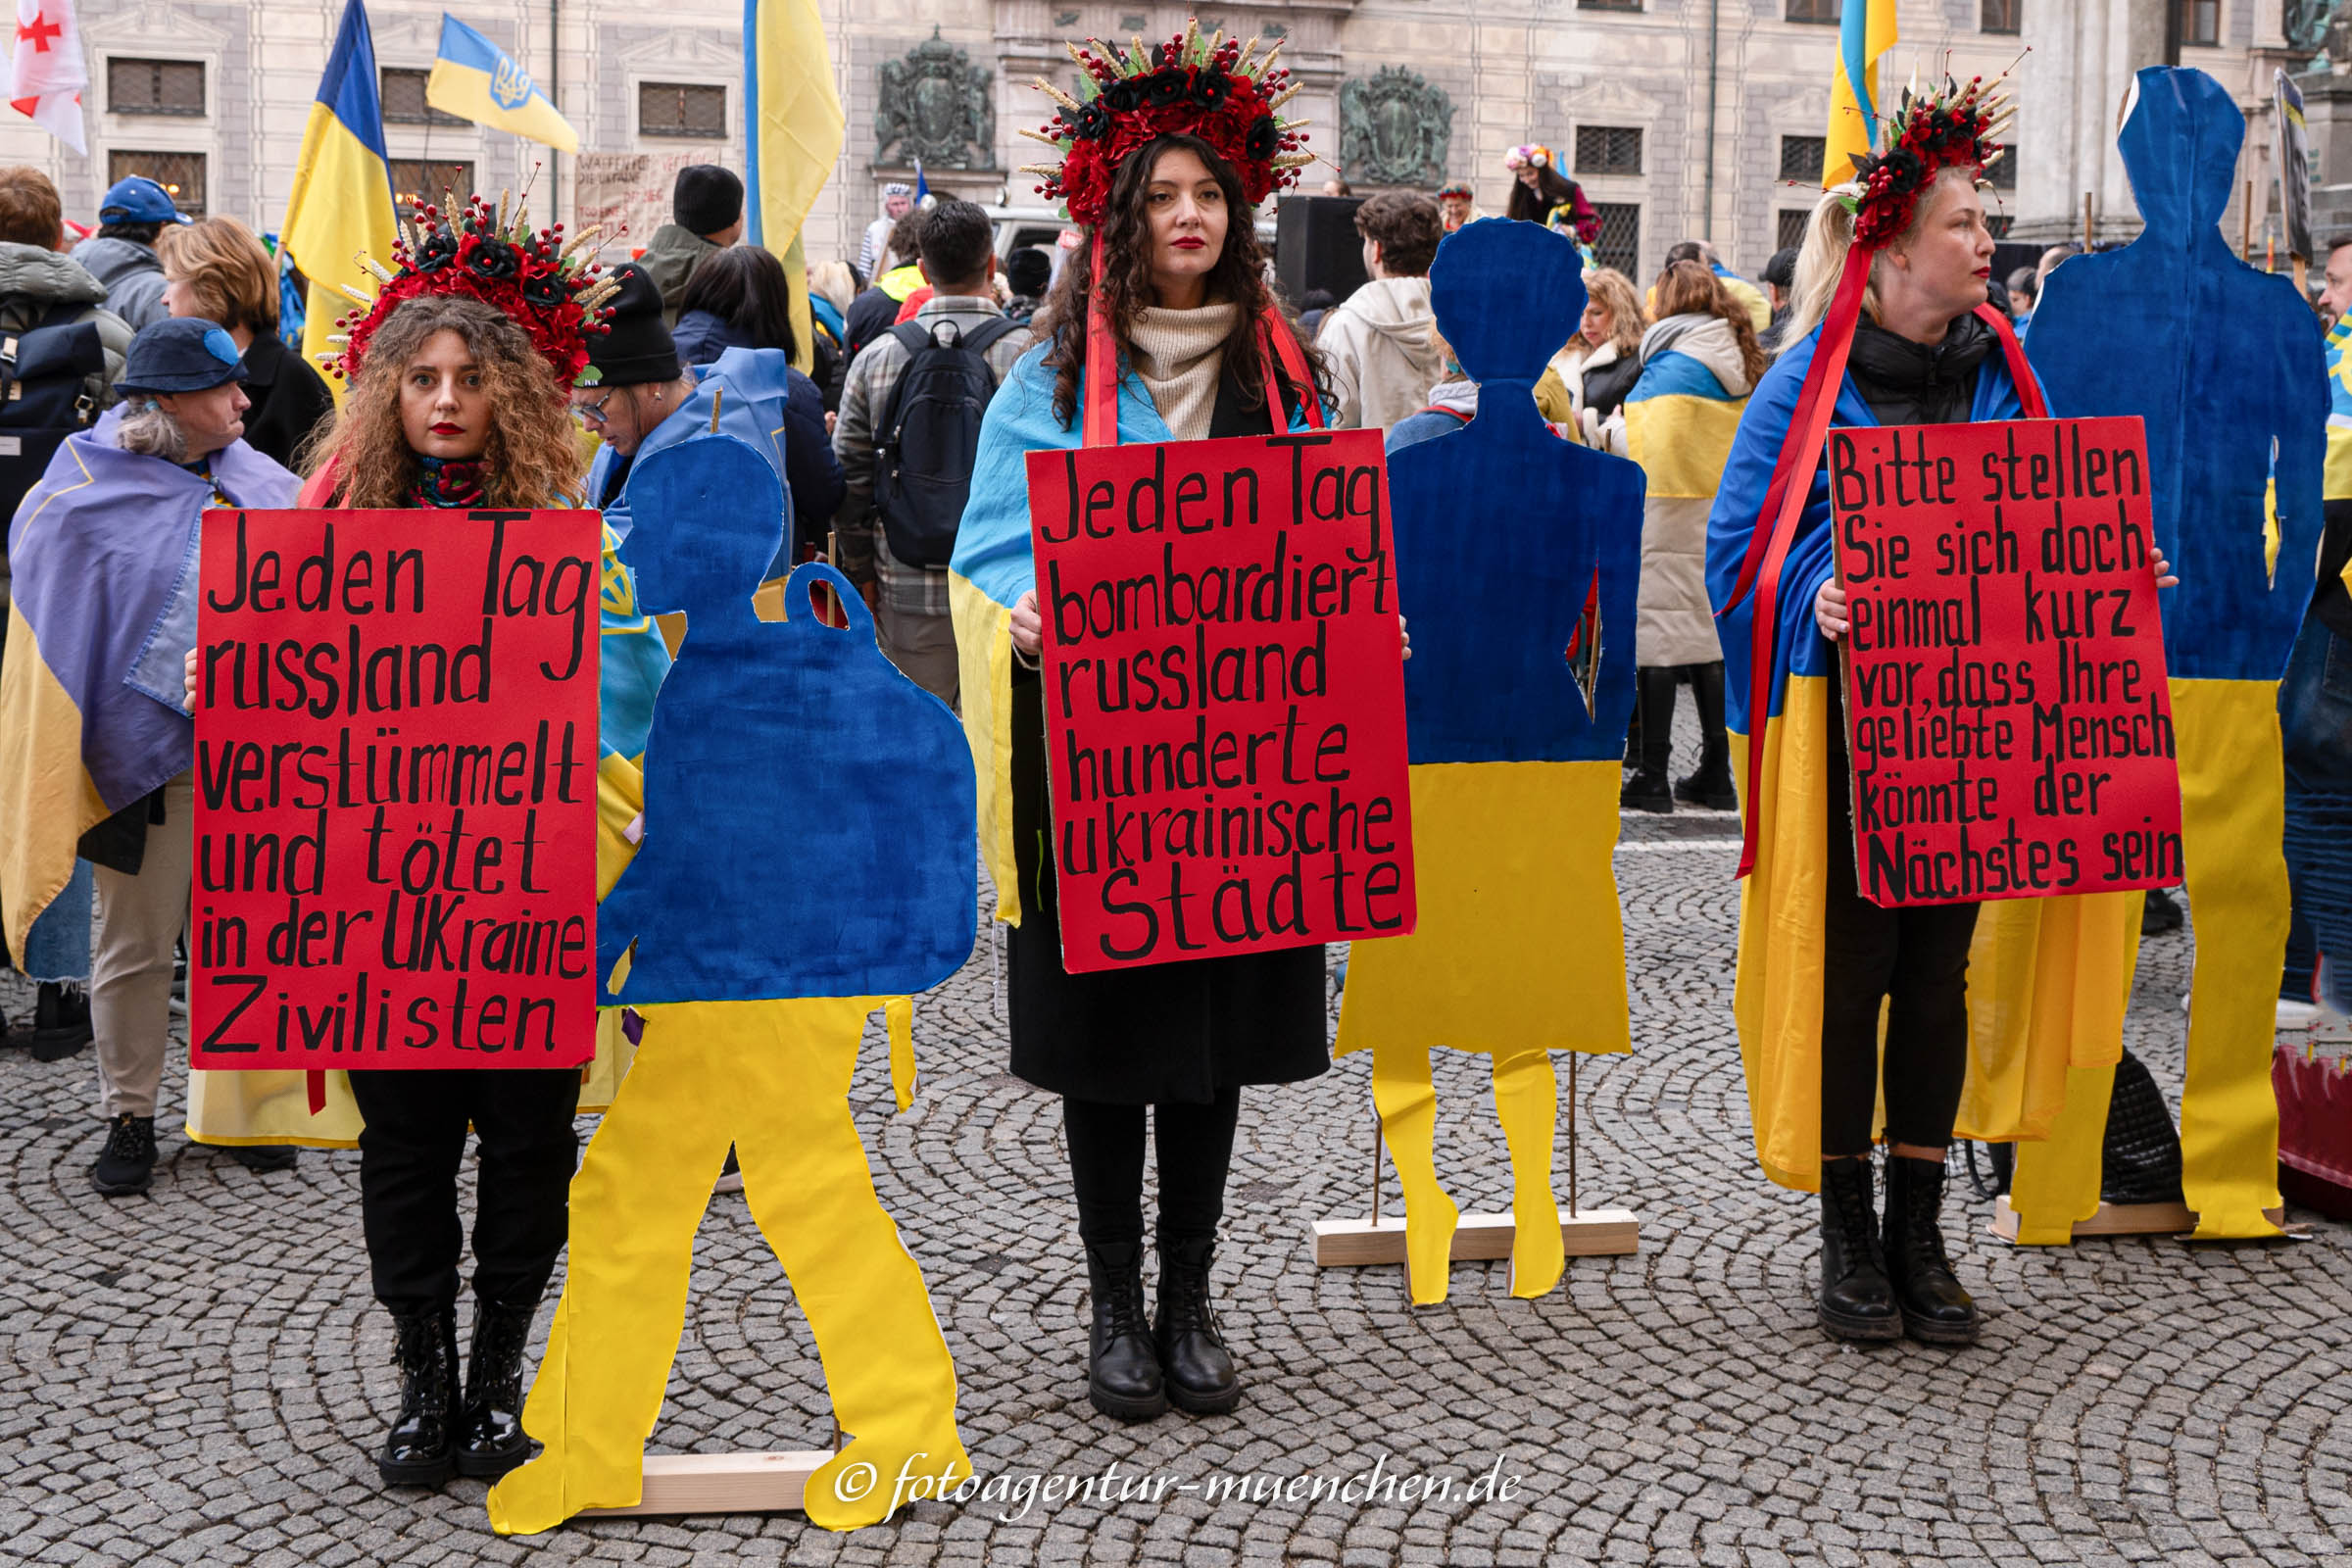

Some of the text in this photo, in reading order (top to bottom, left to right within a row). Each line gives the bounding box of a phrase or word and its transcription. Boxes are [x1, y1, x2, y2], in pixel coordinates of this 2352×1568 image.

[1042, 434, 1381, 564] Jeden Tag
[1834, 423, 2141, 512] Bitte stellen
[1844, 498, 2145, 584] Sie sich doch
[208, 511, 593, 681] Jeden Tag
[1049, 530, 1392, 647] bombardiert
[1850, 570, 2137, 652] einmal kurz
[205, 617, 493, 720] russland
[1059, 619, 1328, 719] russland
[2058, 639, 2142, 706] Ihre
[199, 720, 584, 813] verstümmelt
[1066, 705, 1351, 803] hunderte
[1856, 691, 2176, 774] geliebte Mensch
[1063, 787, 1396, 876] ukrainische
[1857, 752, 2113, 833] könnte der
[201, 806, 550, 897] und tötet
[1867, 815, 2182, 904] Nächstes sein
[202, 906, 249, 968] in
[268, 897, 373, 968] der
[1101, 851, 1403, 961] Städte
[202, 971, 557, 1054] Zivilisten
